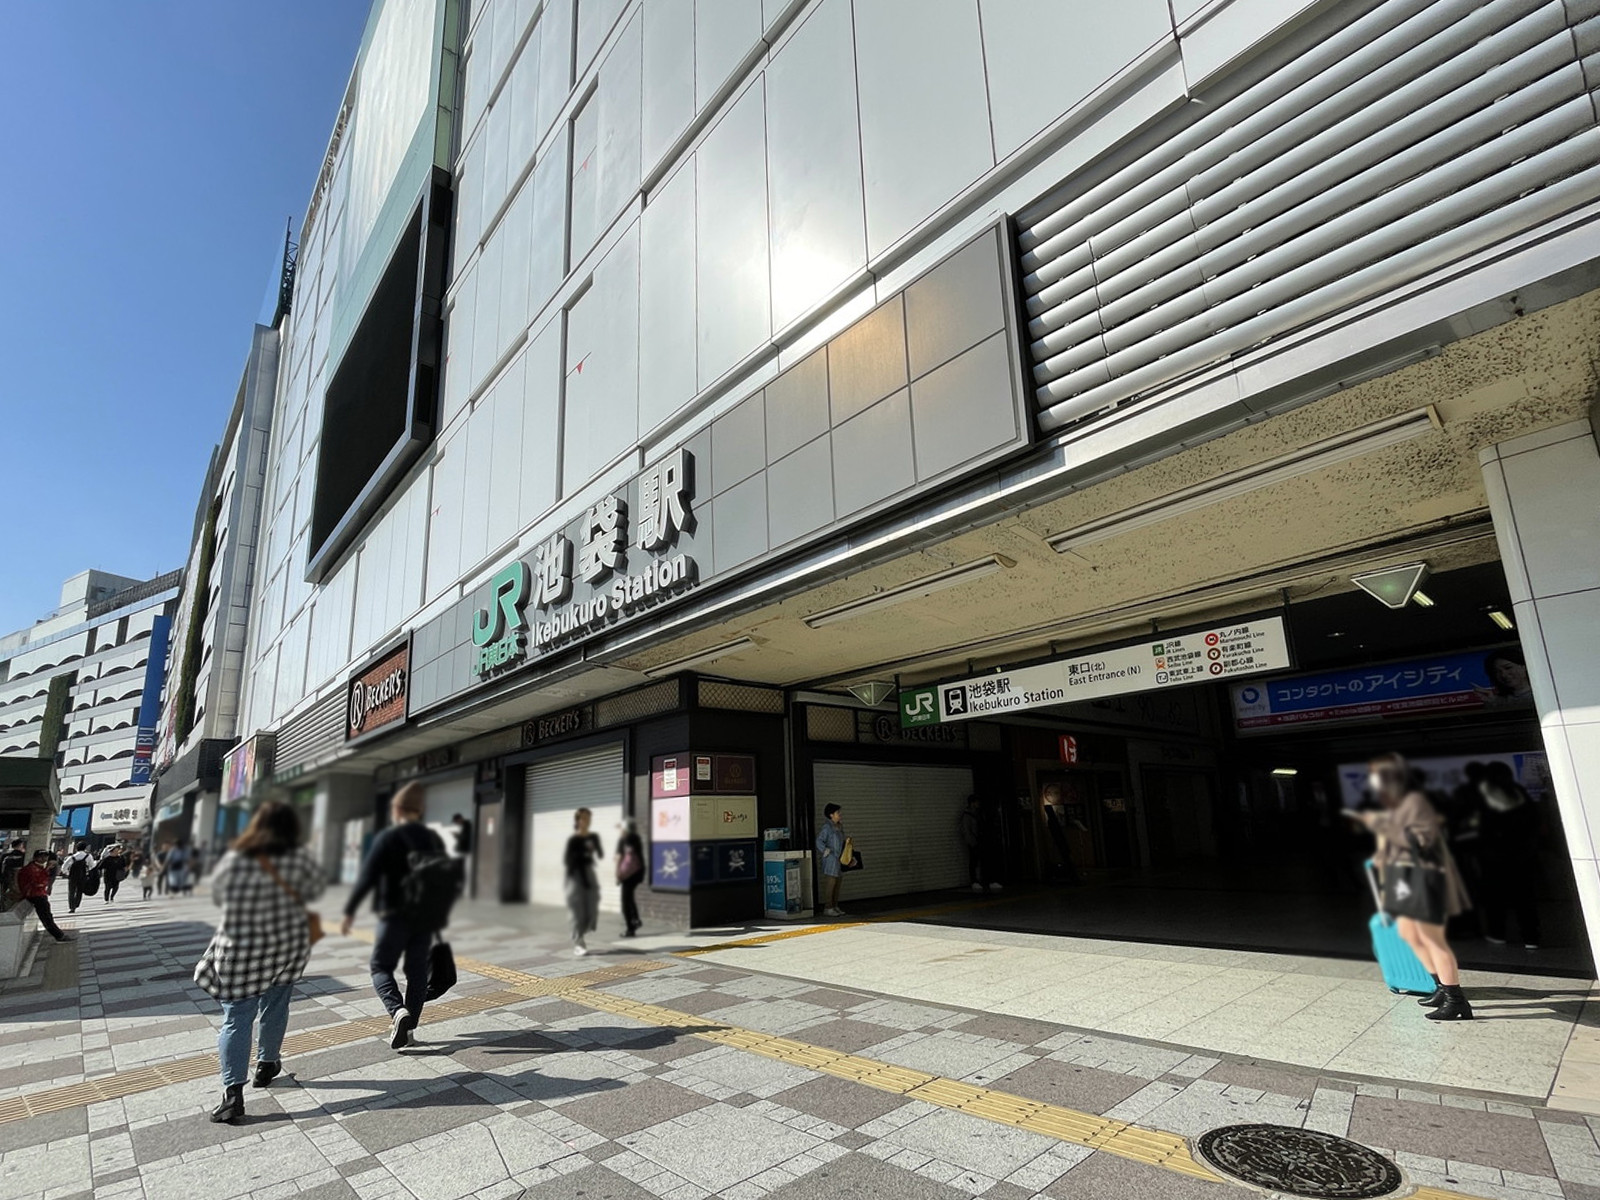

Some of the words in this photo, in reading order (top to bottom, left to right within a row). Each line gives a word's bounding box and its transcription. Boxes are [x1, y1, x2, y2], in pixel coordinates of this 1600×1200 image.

[533, 447, 688, 610] 池袋駅
[472, 559, 525, 647] JR
[532, 593, 607, 649] Ikebukuro
[611, 552, 686, 611] Station
[1219, 626, 1250, 638] 丸ノ内線
[1220, 632, 1253, 644] Marunouchi
[1253, 631, 1265, 639] Line
[472, 631, 520, 677] JR東日本
[1252, 647, 1264, 655] Line
[1068, 660, 1106, 677] 東口(北)
[1068, 676, 1088, 686] East
[1088, 668, 1126, 683] Entrance
[1127, 664, 1142, 676] (N)
[1256, 661, 1267, 669] Line
[366, 668, 402, 711] BECKER'S
[968, 677, 1011, 699] 池袋駅
[1277, 665, 1464, 702] コンタクトのアイシティ
[906, 692, 934, 716] JR
[969, 694, 1020, 713] Ikebukuro
[1024, 687, 1064, 704] Station
[538, 709, 580, 740] BECKER'S
[134, 726, 155, 775] SEIBU
